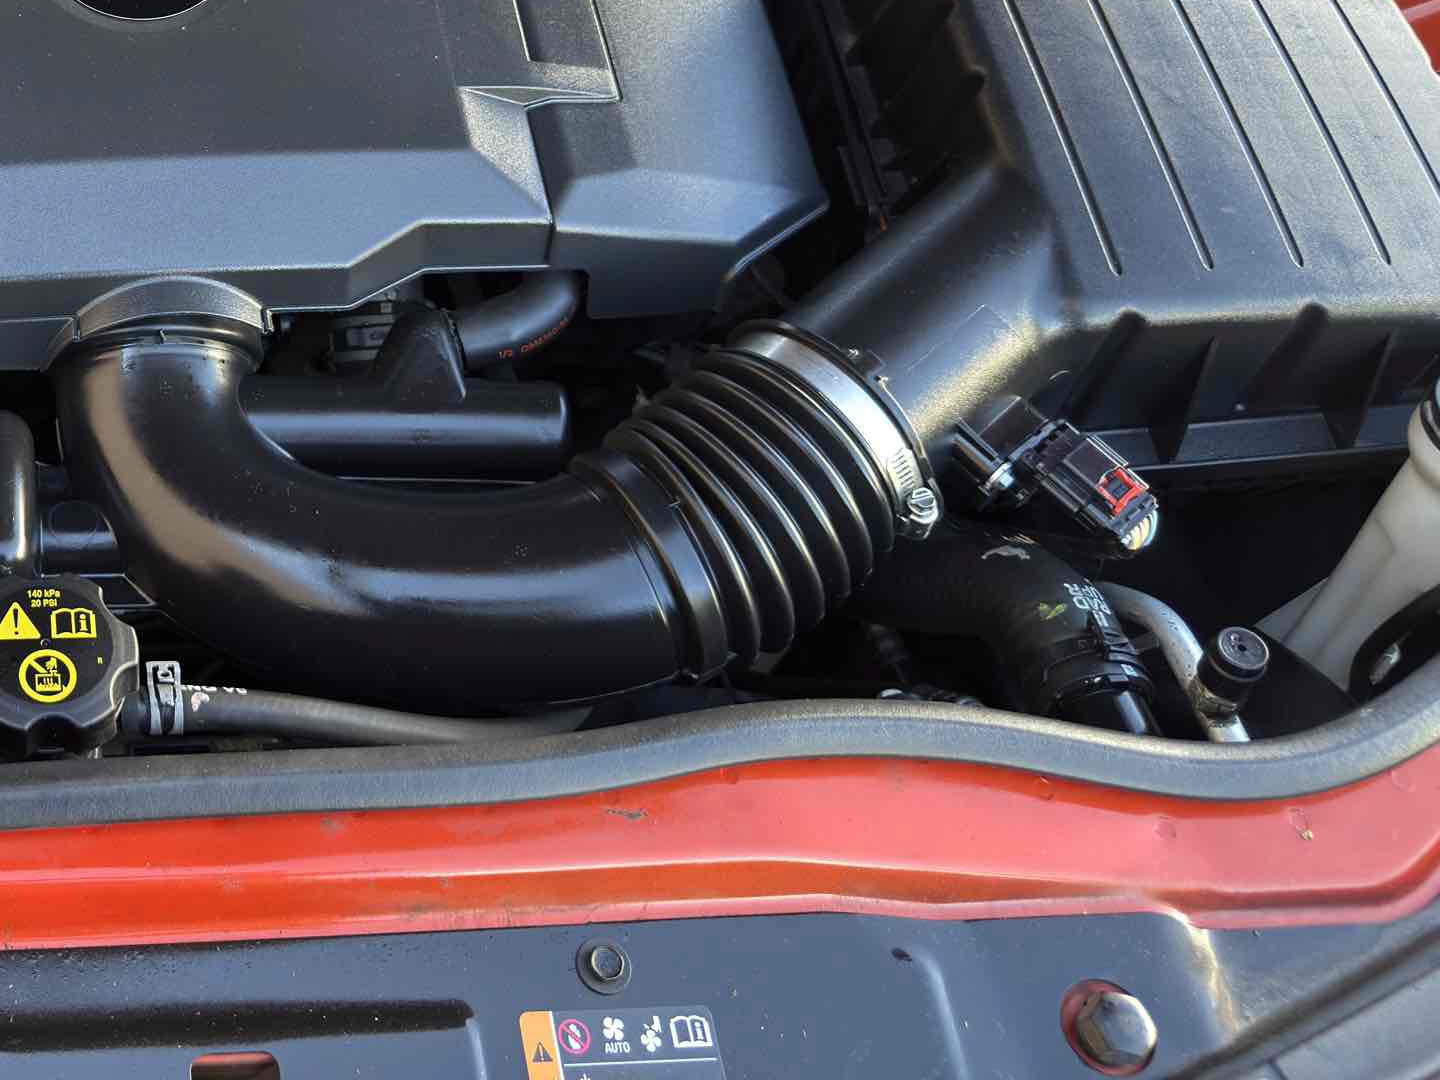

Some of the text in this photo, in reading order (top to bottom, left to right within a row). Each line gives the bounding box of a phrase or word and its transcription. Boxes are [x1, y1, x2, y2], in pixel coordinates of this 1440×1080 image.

[27, 589, 61, 598] 140 kPa
[30, 598, 57, 608] 20 PSI
[604, 1041, 631, 1054] AUTO
